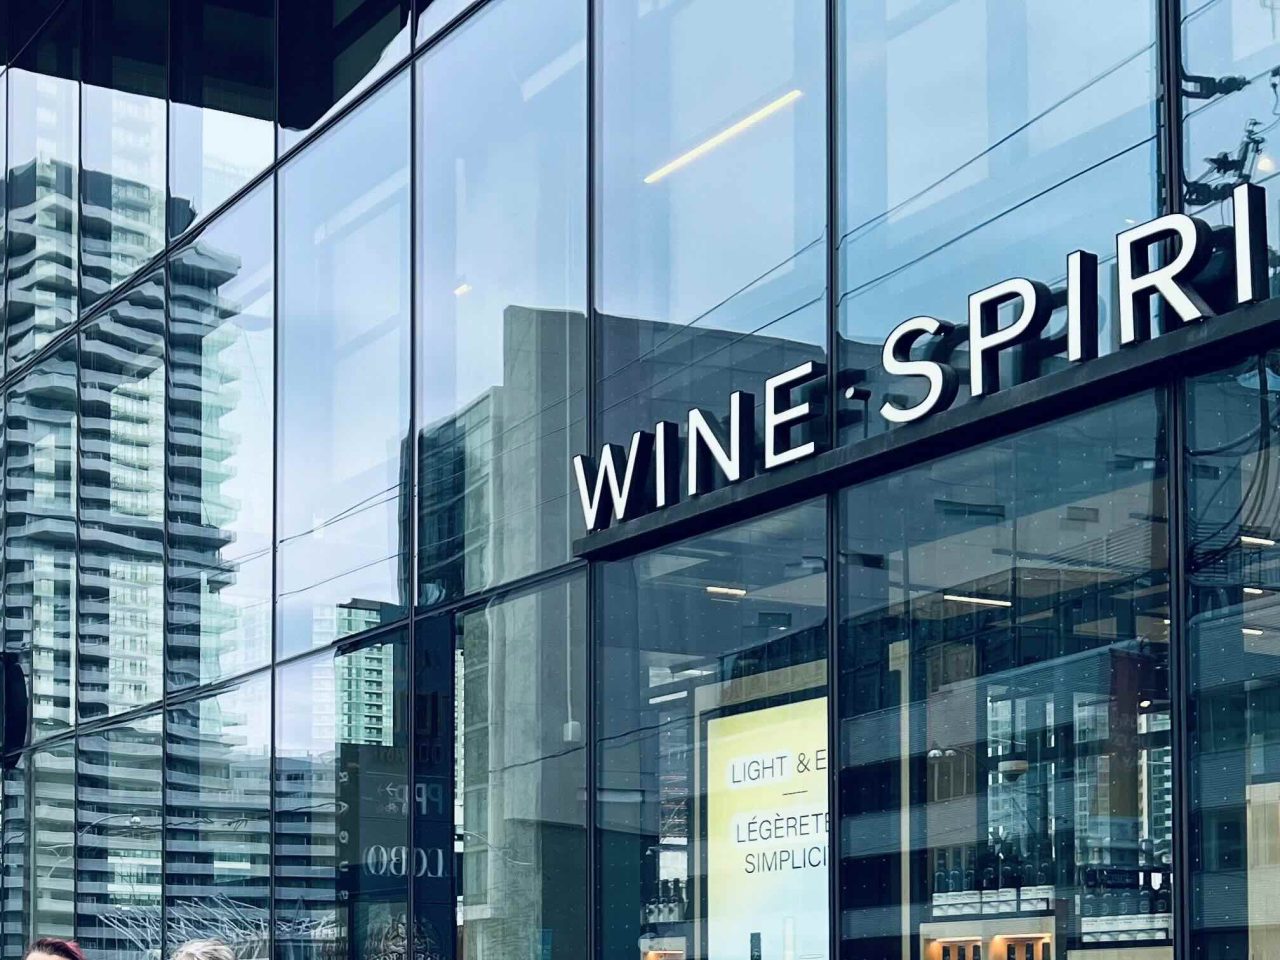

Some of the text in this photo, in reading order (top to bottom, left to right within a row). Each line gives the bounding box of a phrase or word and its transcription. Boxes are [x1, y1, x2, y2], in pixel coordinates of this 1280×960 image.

[572, 360, 818, 531] WINE
[732, 755, 787, 784] LIGHT
[796, 752, 811, 774] &
[744, 846, 829, 875] SIMPLICI
